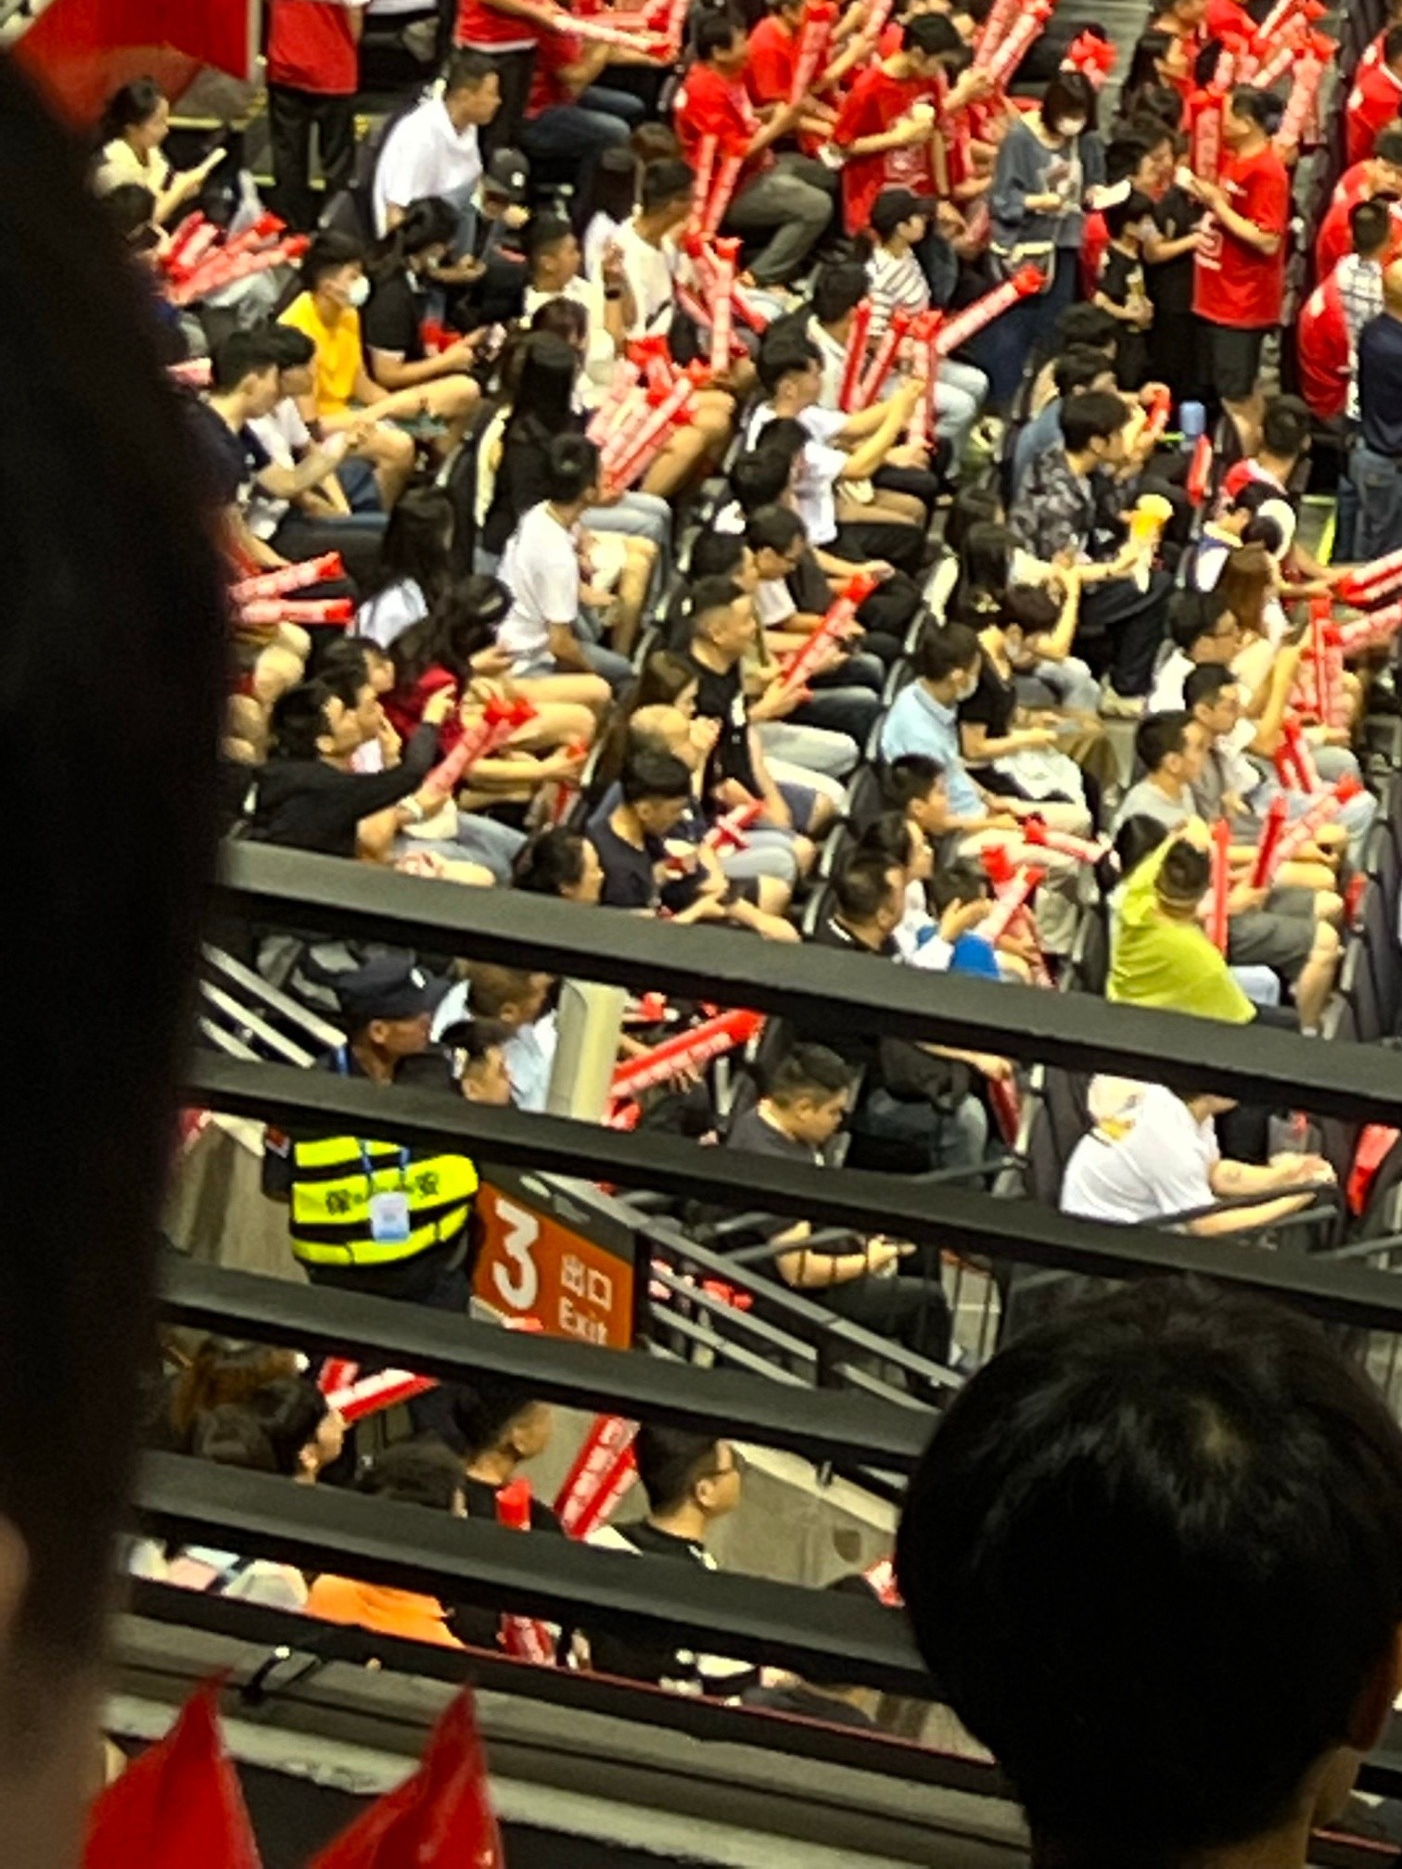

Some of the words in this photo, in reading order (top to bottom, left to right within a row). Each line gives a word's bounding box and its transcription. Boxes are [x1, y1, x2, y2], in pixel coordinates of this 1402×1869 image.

[492, 1197, 540, 1311] 3
[560, 1253, 613, 1312] 出口
[558, 1295, 608, 1346] Exit
